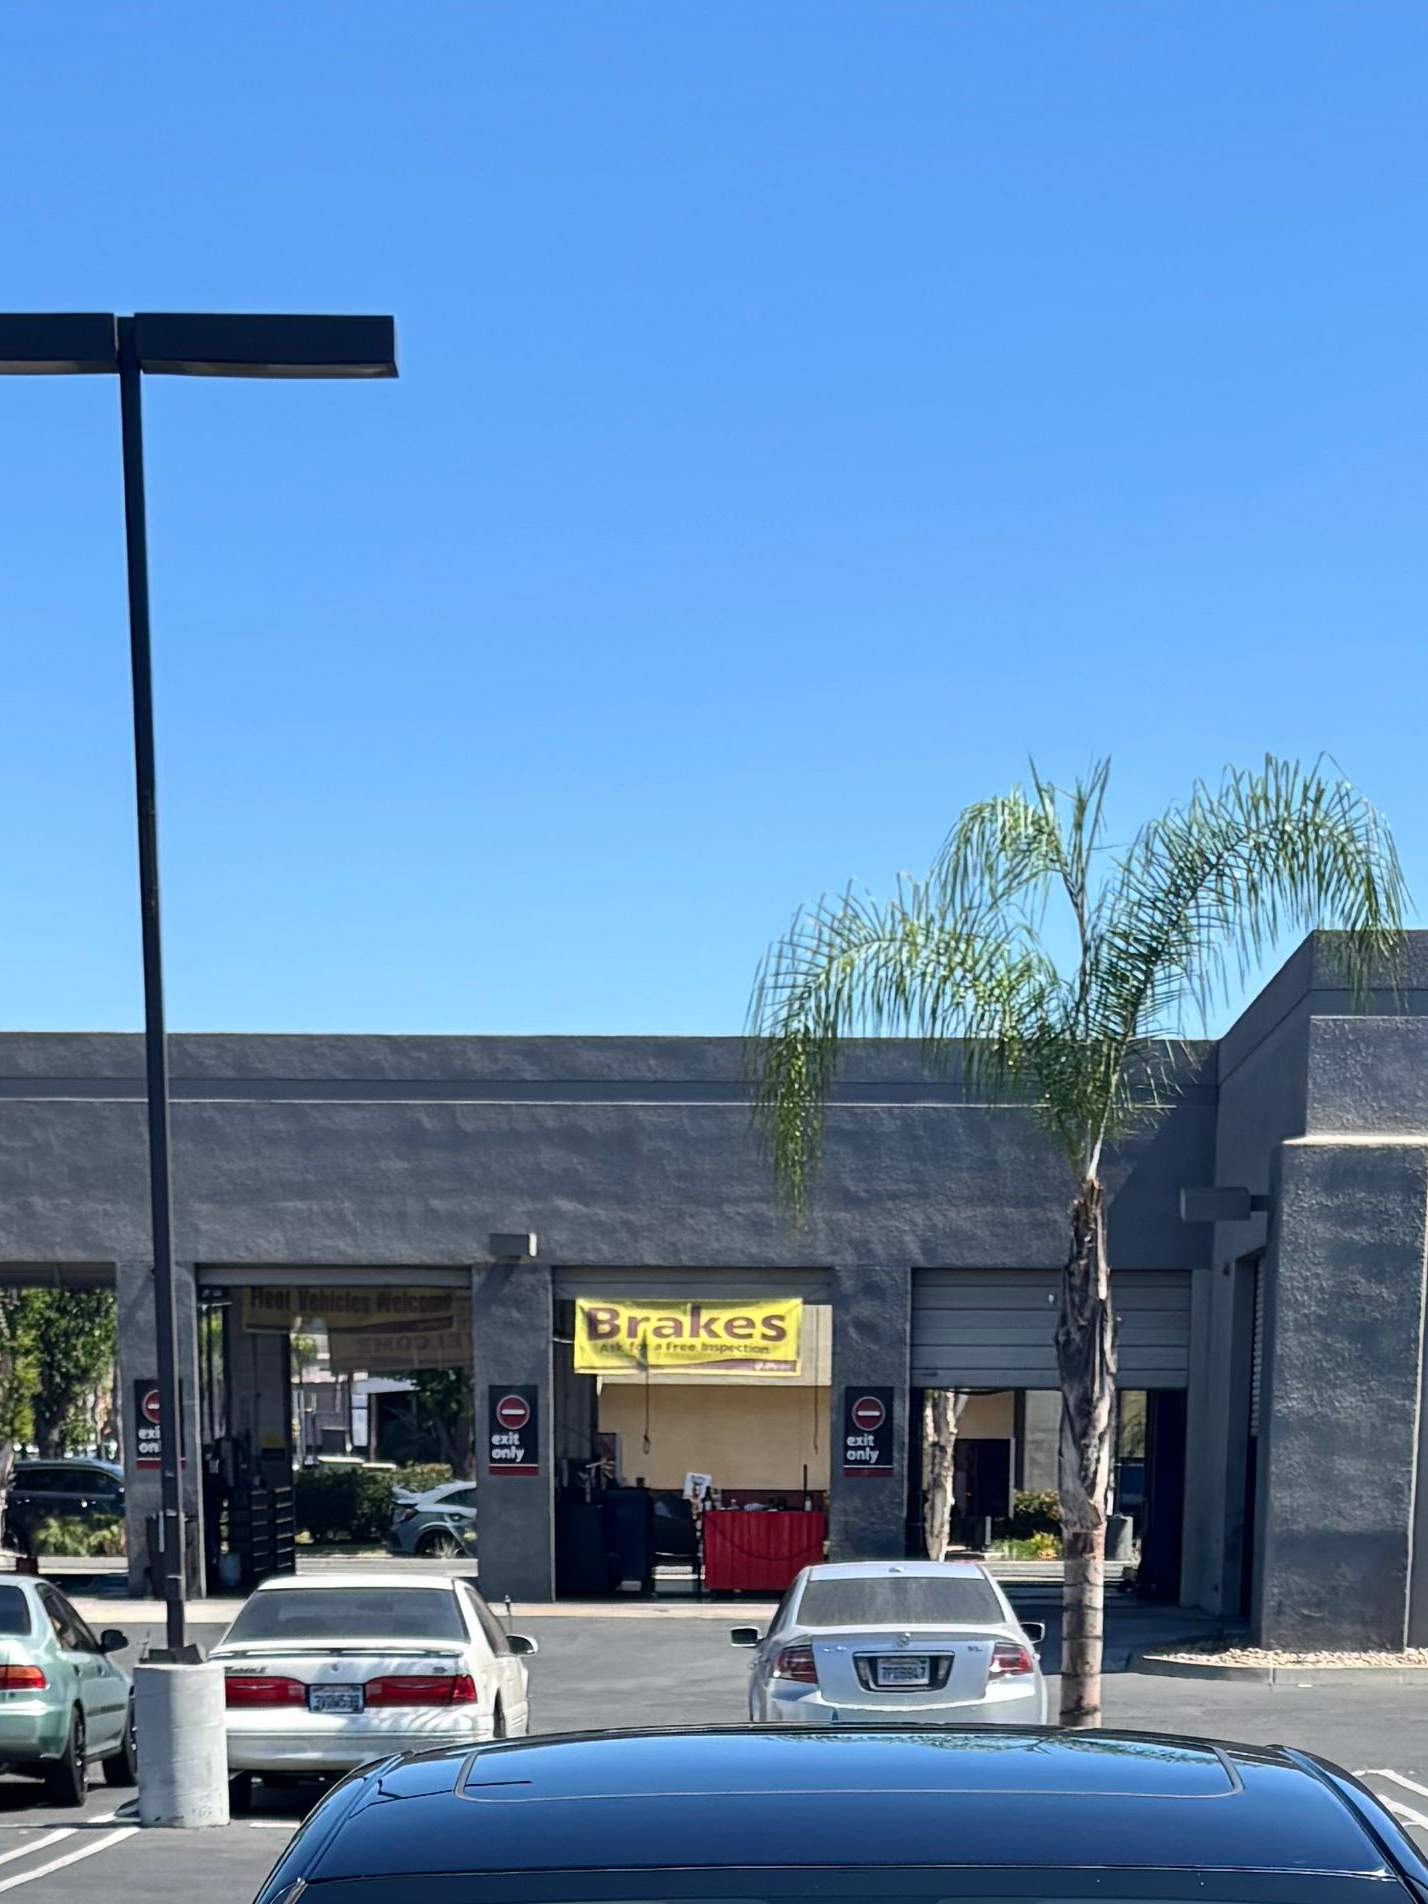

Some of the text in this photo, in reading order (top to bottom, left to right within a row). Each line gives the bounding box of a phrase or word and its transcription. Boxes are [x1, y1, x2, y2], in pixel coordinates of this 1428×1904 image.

[587, 1304, 787, 1342] Brakes
[654, 1344, 662, 1352] a
[666, 1343, 696, 1352] Free
[701, 1342, 770, 1354] Inspection
[138, 1425, 161, 1440] exi
[491, 1431, 520, 1446] exit
[846, 1433, 875, 1447] exit
[491, 1445, 525, 1462] only
[846, 1446, 879, 1464] only
